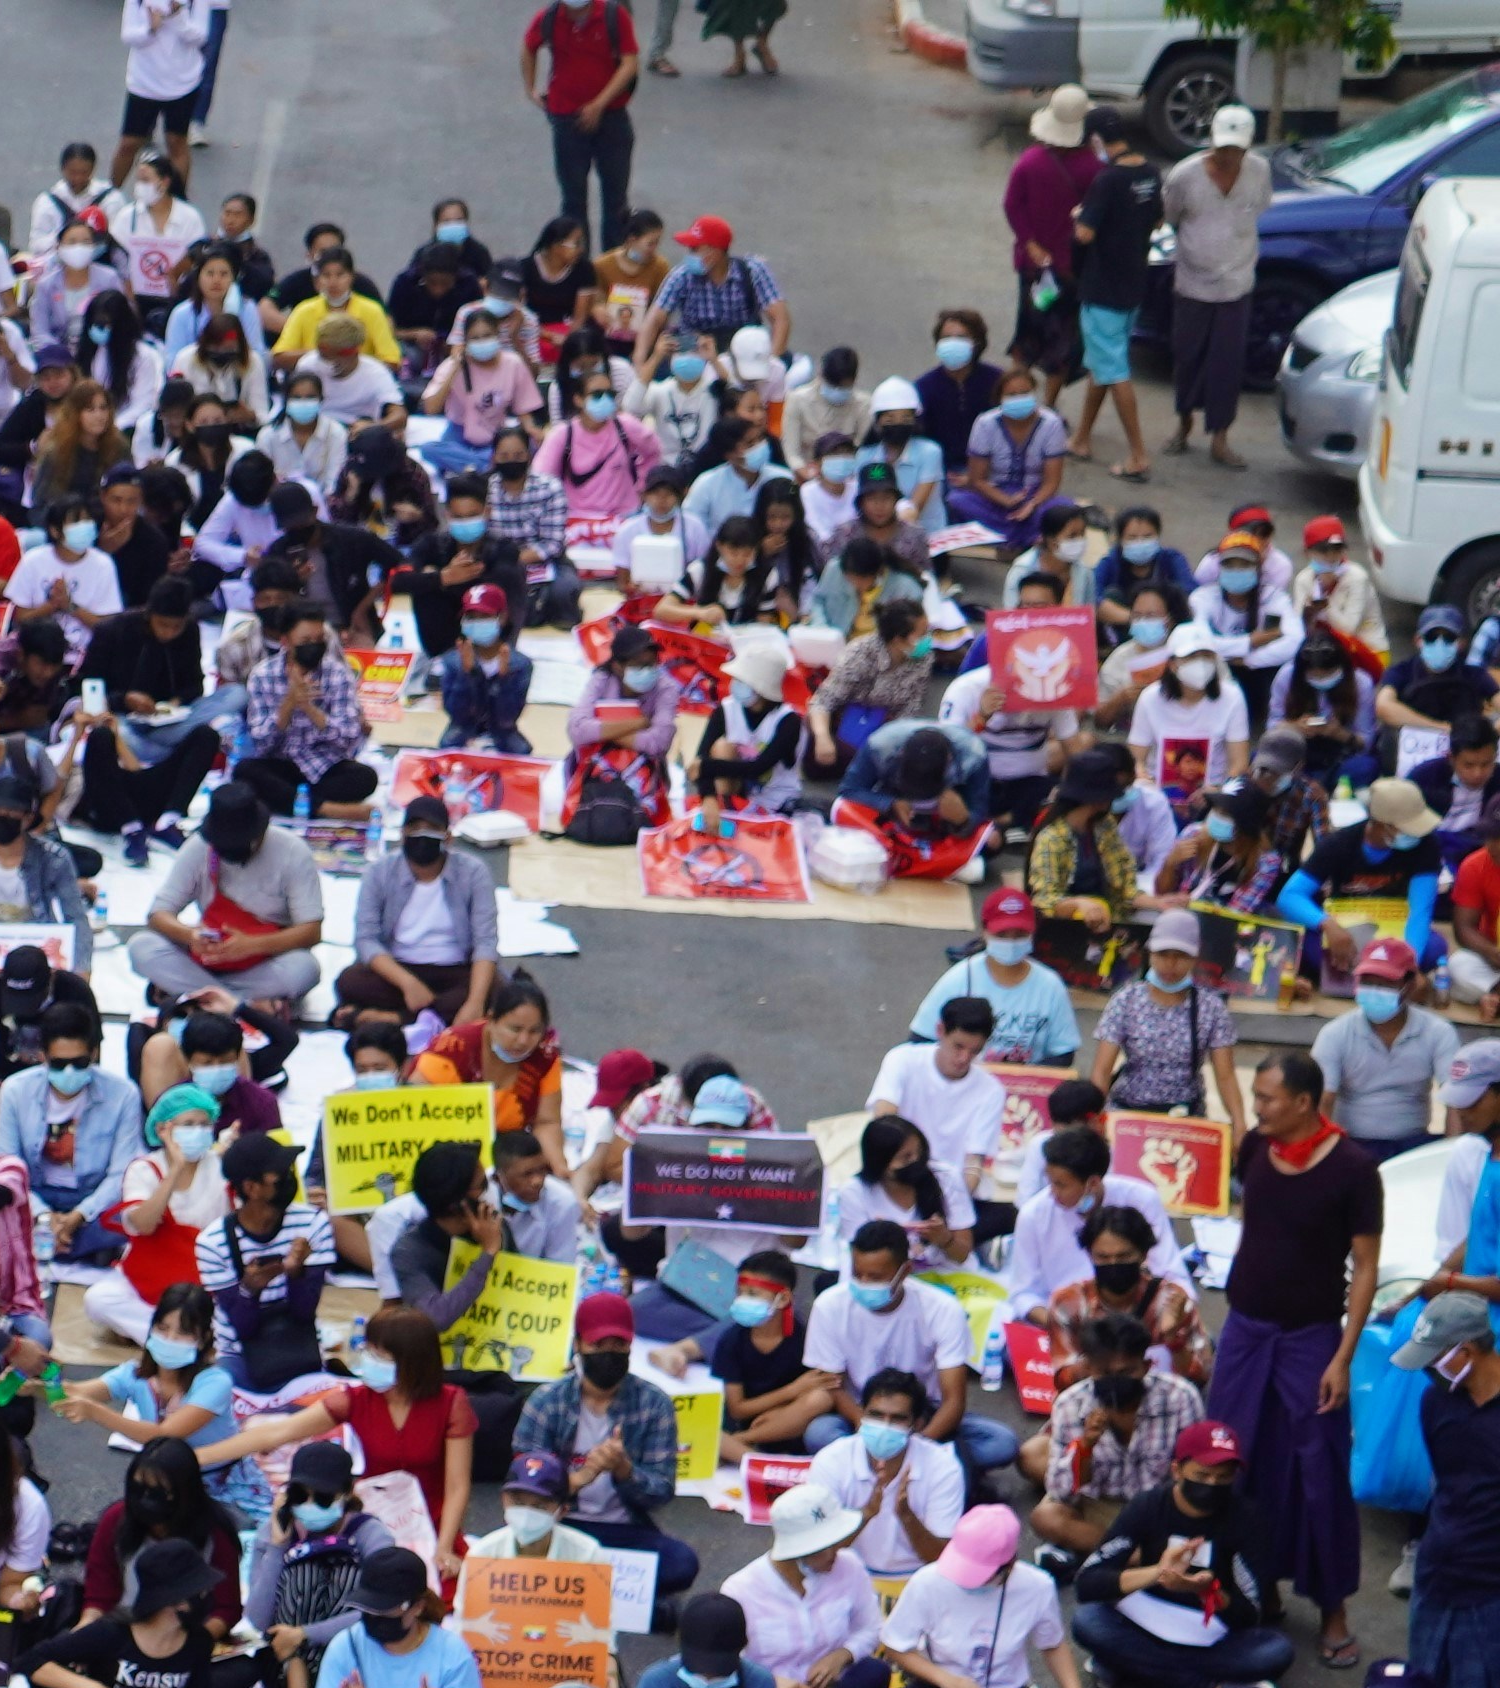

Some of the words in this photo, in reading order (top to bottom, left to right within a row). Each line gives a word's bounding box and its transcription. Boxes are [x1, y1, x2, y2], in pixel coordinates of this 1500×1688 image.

[331, 1108, 360, 1128] We
[366, 1104, 412, 1124] Don't
[419, 1102, 484, 1126] Accept
[337, 1141, 422, 1163] MILITARY
[656, 1164, 684, 1179] WE
[685, 1164, 710, 1180] DO
[711, 1165, 747, 1181] NOT
[748, 1166, 796, 1183] WANT
[502, 1270, 568, 1300] Accept
[506, 1309, 561, 1335] COUP
[490, 1572, 547, 1592] HELP
[553, 1574, 586, 1594] US
[472, 1649, 525, 1668] STOP
[530, 1652, 594, 1672] CRIME
